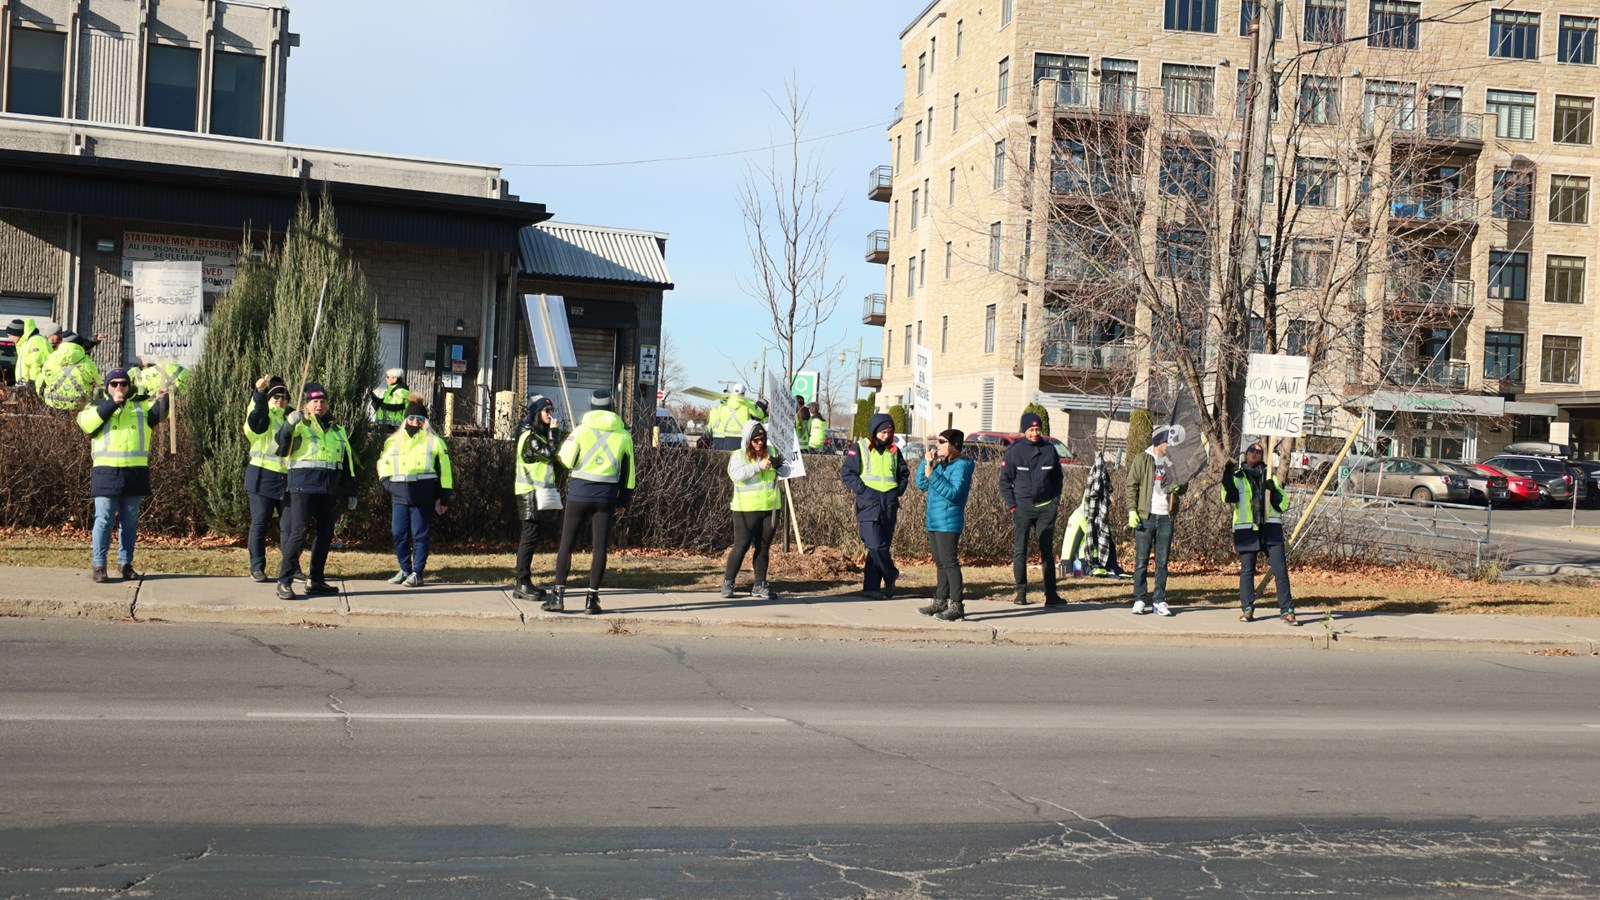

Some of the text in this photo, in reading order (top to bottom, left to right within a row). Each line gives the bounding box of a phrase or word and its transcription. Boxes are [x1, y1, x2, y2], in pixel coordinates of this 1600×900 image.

[124, 232, 196, 248] STATIONNEMENT
[142, 244, 190, 254] PERSONNEL
[193, 248, 232, 257] AUTORISE
[154, 252, 206, 261] SEULEMENT
[202, 266, 223, 276] RVED
[1275, 376, 1305, 394] VAUT
[1248, 410, 1301, 433] PEANUTS
